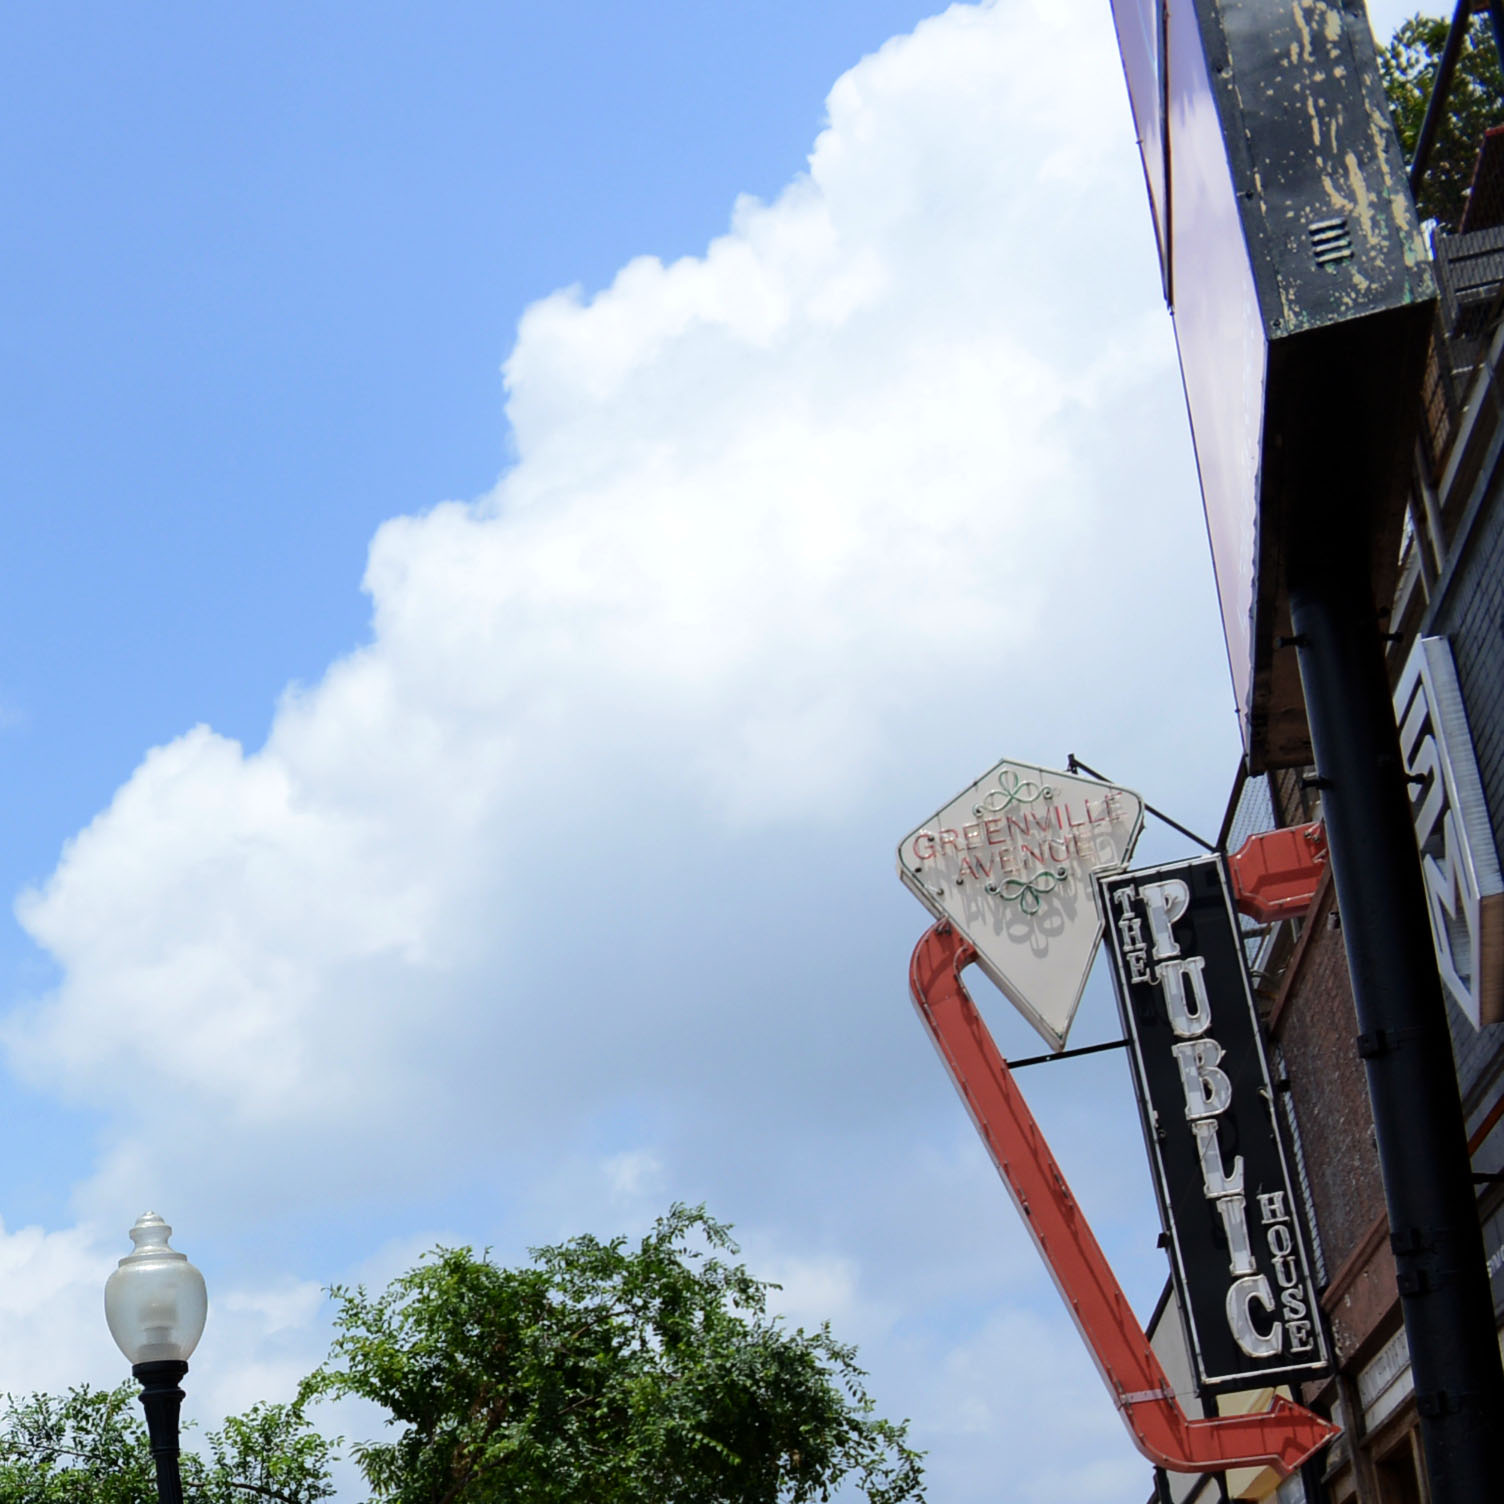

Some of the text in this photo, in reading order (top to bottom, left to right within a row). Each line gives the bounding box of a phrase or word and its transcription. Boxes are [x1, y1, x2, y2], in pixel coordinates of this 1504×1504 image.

[912, 791, 1130, 861] GREENVILLE
[958, 833, 1096, 881] AVENUE
[1113, 884, 1160, 986] THE
[1139, 878, 1283, 1358] PUBLIC
[1257, 1191, 1314, 1354] HOUSE
